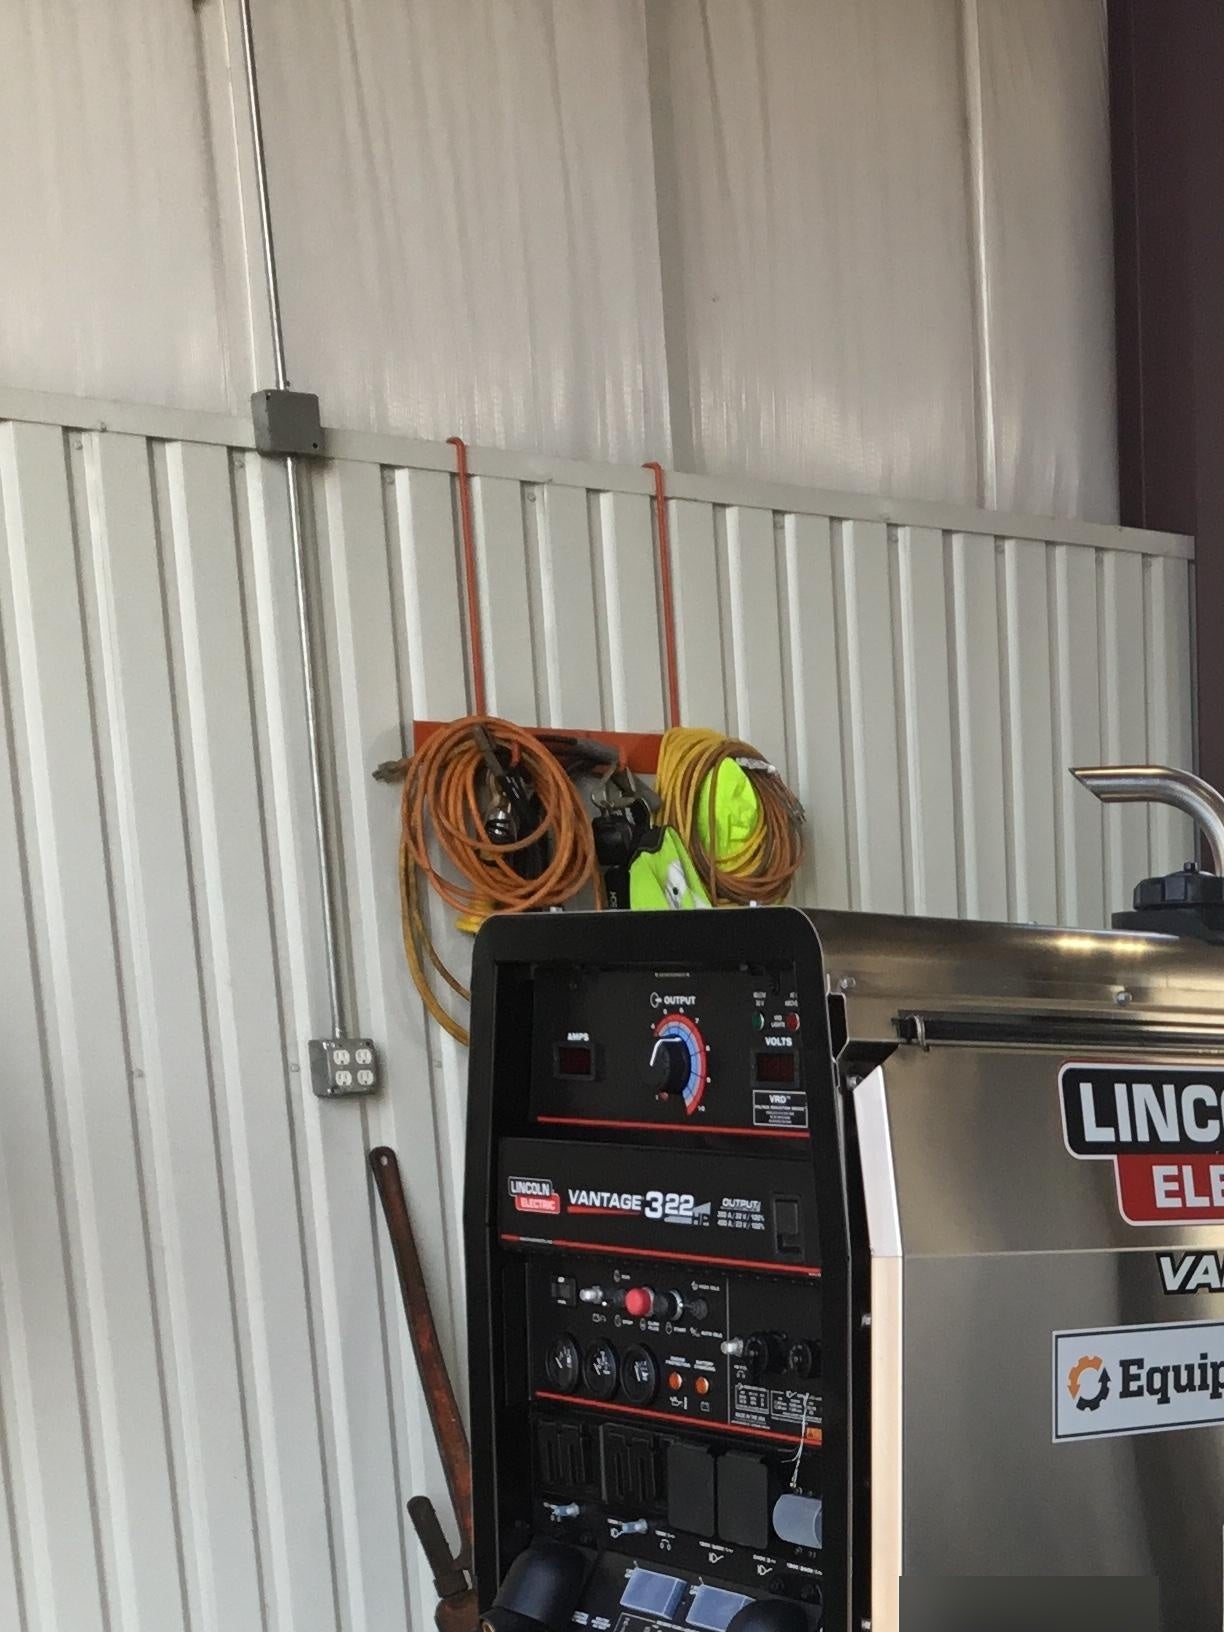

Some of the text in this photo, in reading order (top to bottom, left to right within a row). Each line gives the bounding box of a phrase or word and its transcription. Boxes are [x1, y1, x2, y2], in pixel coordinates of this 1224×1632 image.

[664, 995, 697, 1006] OUTPUT
[567, 1032, 590, 1042] AMPS
[764, 1036, 793, 1047] VOLTS
[510, 1180, 550, 1197] LINCOLN
[520, 1196, 556, 1211] ELECTRIC
[567, 1188, 643, 1211] VANTAGE
[644, 1190, 695, 1219] 322
[722, 1197, 760, 1209] OUTPUT
